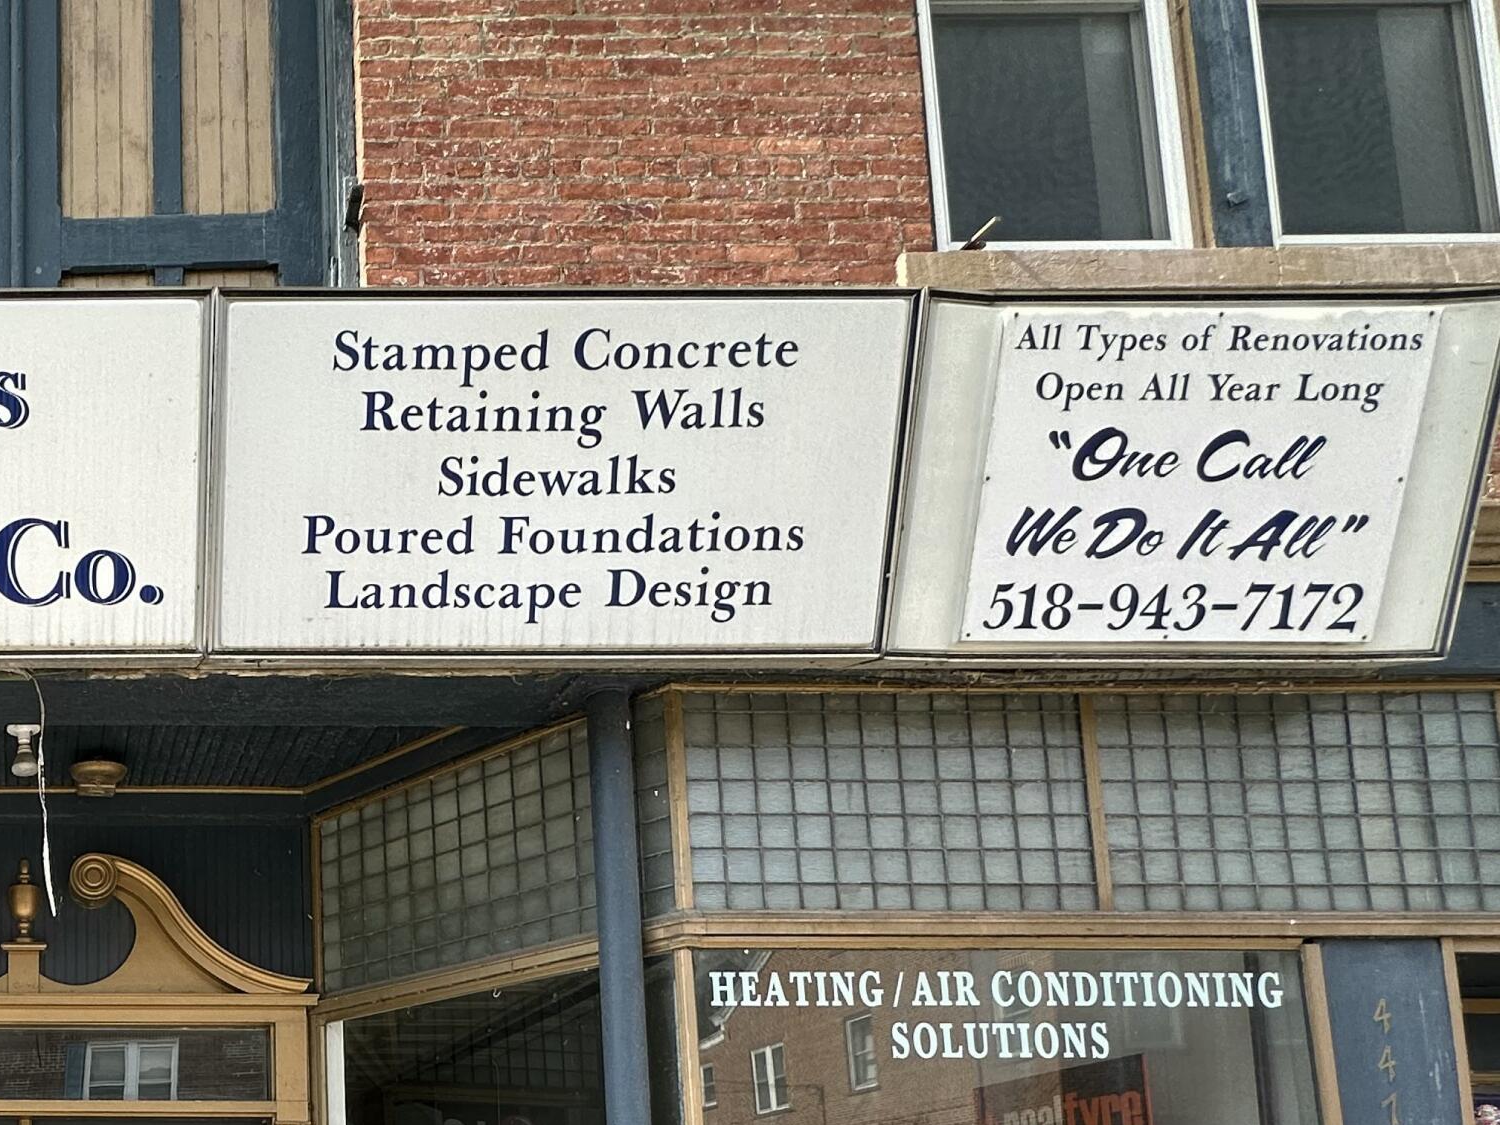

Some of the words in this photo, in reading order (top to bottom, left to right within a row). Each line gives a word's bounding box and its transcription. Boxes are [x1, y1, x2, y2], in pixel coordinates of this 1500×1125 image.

[333, 329, 548, 387] Stamped
[575, 328, 798, 370] Concrete
[1016, 325, 1061, 349] All
[1078, 325, 1166, 361] Types
[1182, 325, 1216, 350] of
[1228, 325, 1422, 350] Renovations
[1037, 373, 1122, 411] Open
[1140, 374, 1189, 400] All
[1209, 374, 1280, 401] Year
[1295, 374, 1384, 412] Long
[360, 391, 607, 448] Retaining
[632, 388, 764, 430] Walls
[439, 455, 675, 496] Sidewalks
[1197, 430, 1326, 482] Call
[302, 516, 474, 554] Poured
[498, 512, 803, 554] Foundations
[1006, 506, 1078, 556] We
[1086, 508, 1163, 559] Do
[1177, 509, 1232, 560] It
[325, 570, 581, 623] Landscape
[605, 567, 771, 622] Design
[983, 583, 1363, 632] 518-943-7172
[709, 971, 884, 1007] HEATING
[893, 972, 903, 1007] /
[912, 972, 980, 1006] AIR
[992, 971, 1283, 1008] CONDITIONING
[892, 1022, 1109, 1059] SOLUTIONS
